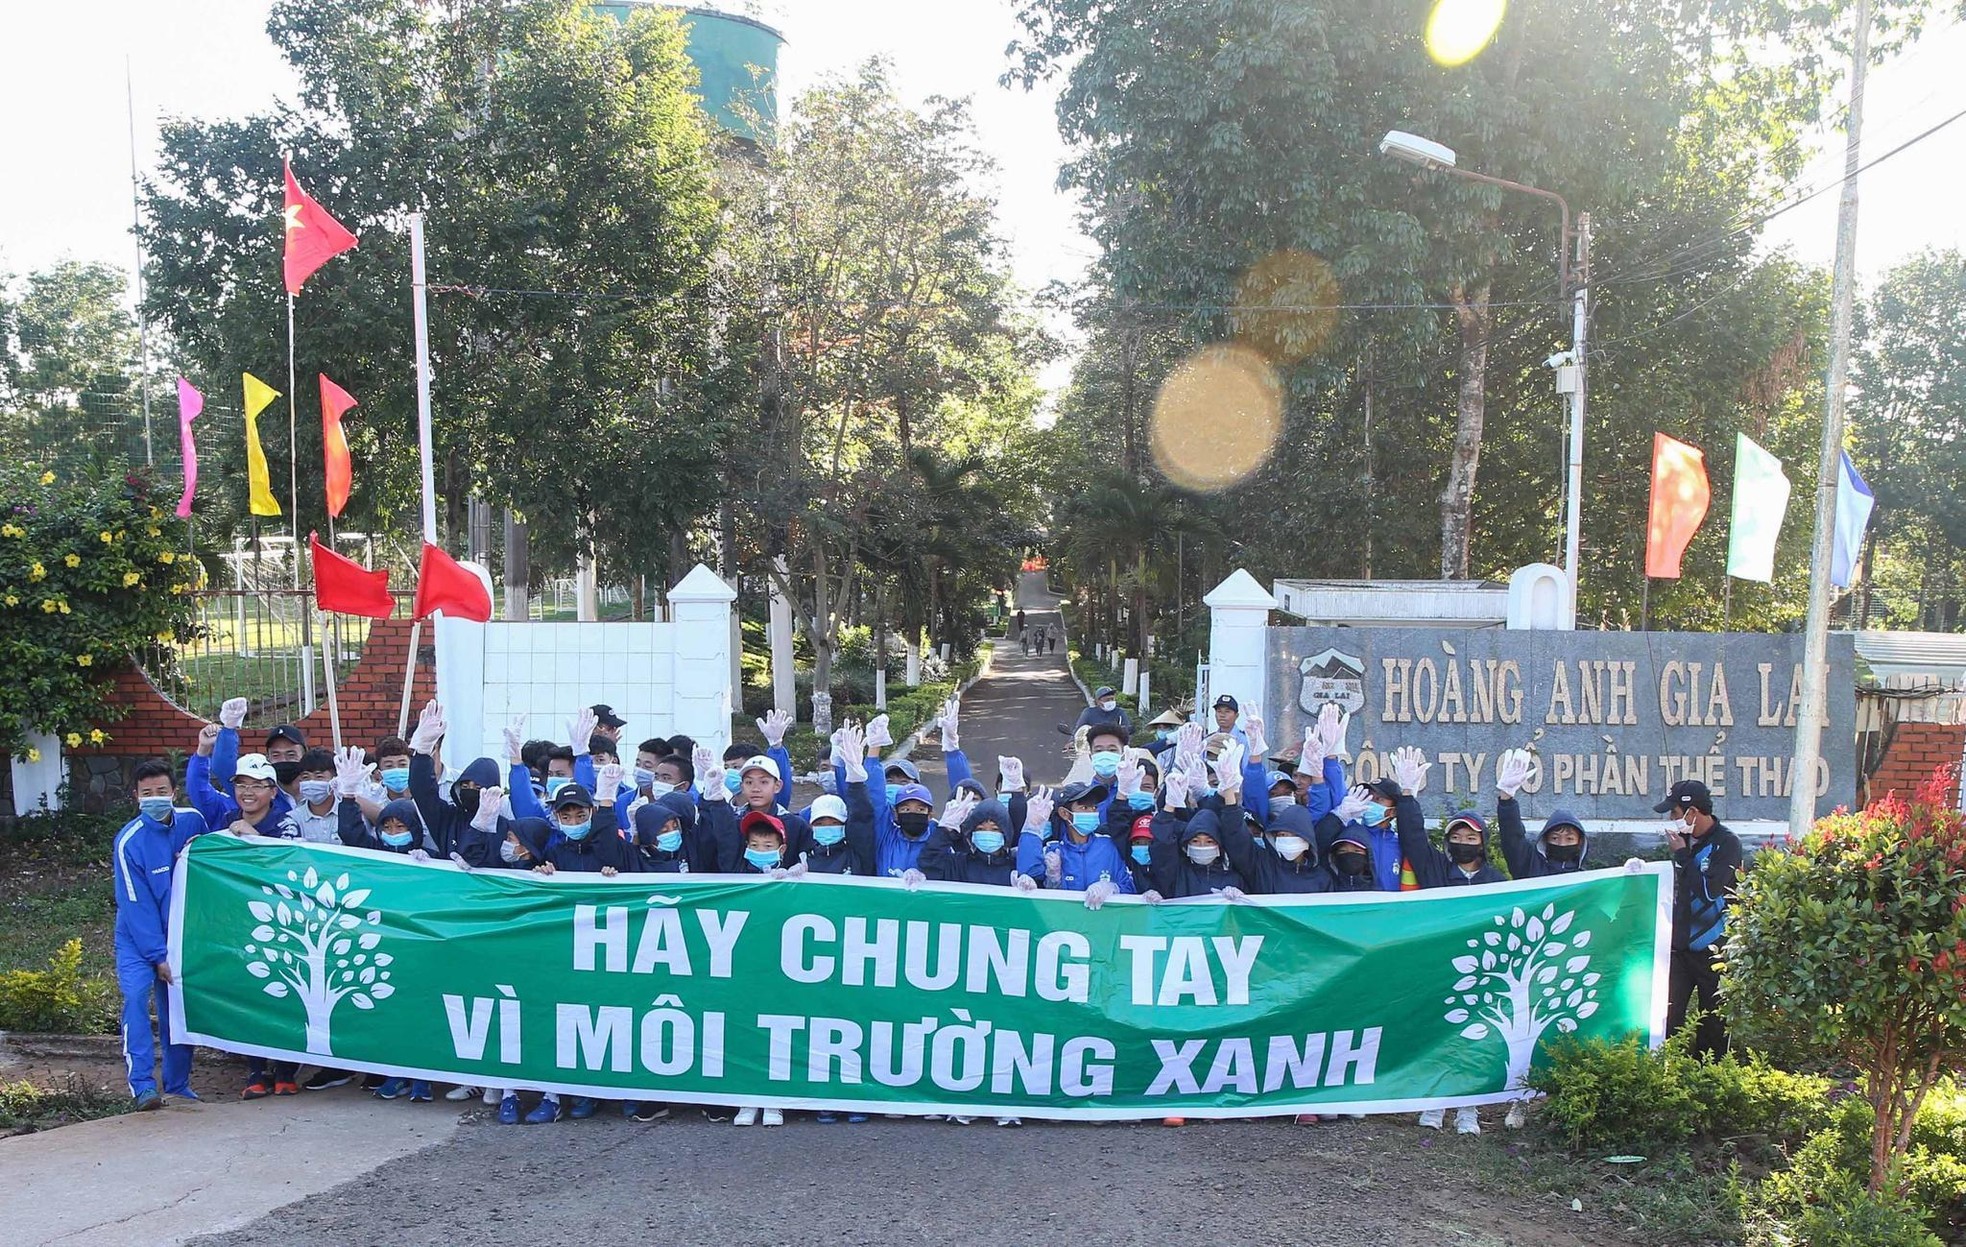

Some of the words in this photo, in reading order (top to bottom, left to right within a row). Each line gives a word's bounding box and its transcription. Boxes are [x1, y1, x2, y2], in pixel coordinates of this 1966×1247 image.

[1381, 640, 1524, 724] HOÀNG
[1545, 660, 1637, 725] ANH
[1660, 660, 1734, 727] GIA
[1337, 739, 1427, 792] ÔN
[1438, 752, 1487, 793] TY
[1553, 733, 1648, 795] PHẦN
[1659, 730, 1726, 796] THỂ
[573, 895, 750, 978] HÃY
[781, 913, 1091, 1003] CHUNG
[1120, 934, 1265, 1006] TAY
[442, 984, 521, 1064] VÌ
[556, 994, 725, 1077] MÔI
[757, 1008, 1116, 1096] TRƯỜNG
[1144, 1026, 1383, 1095] XANH
